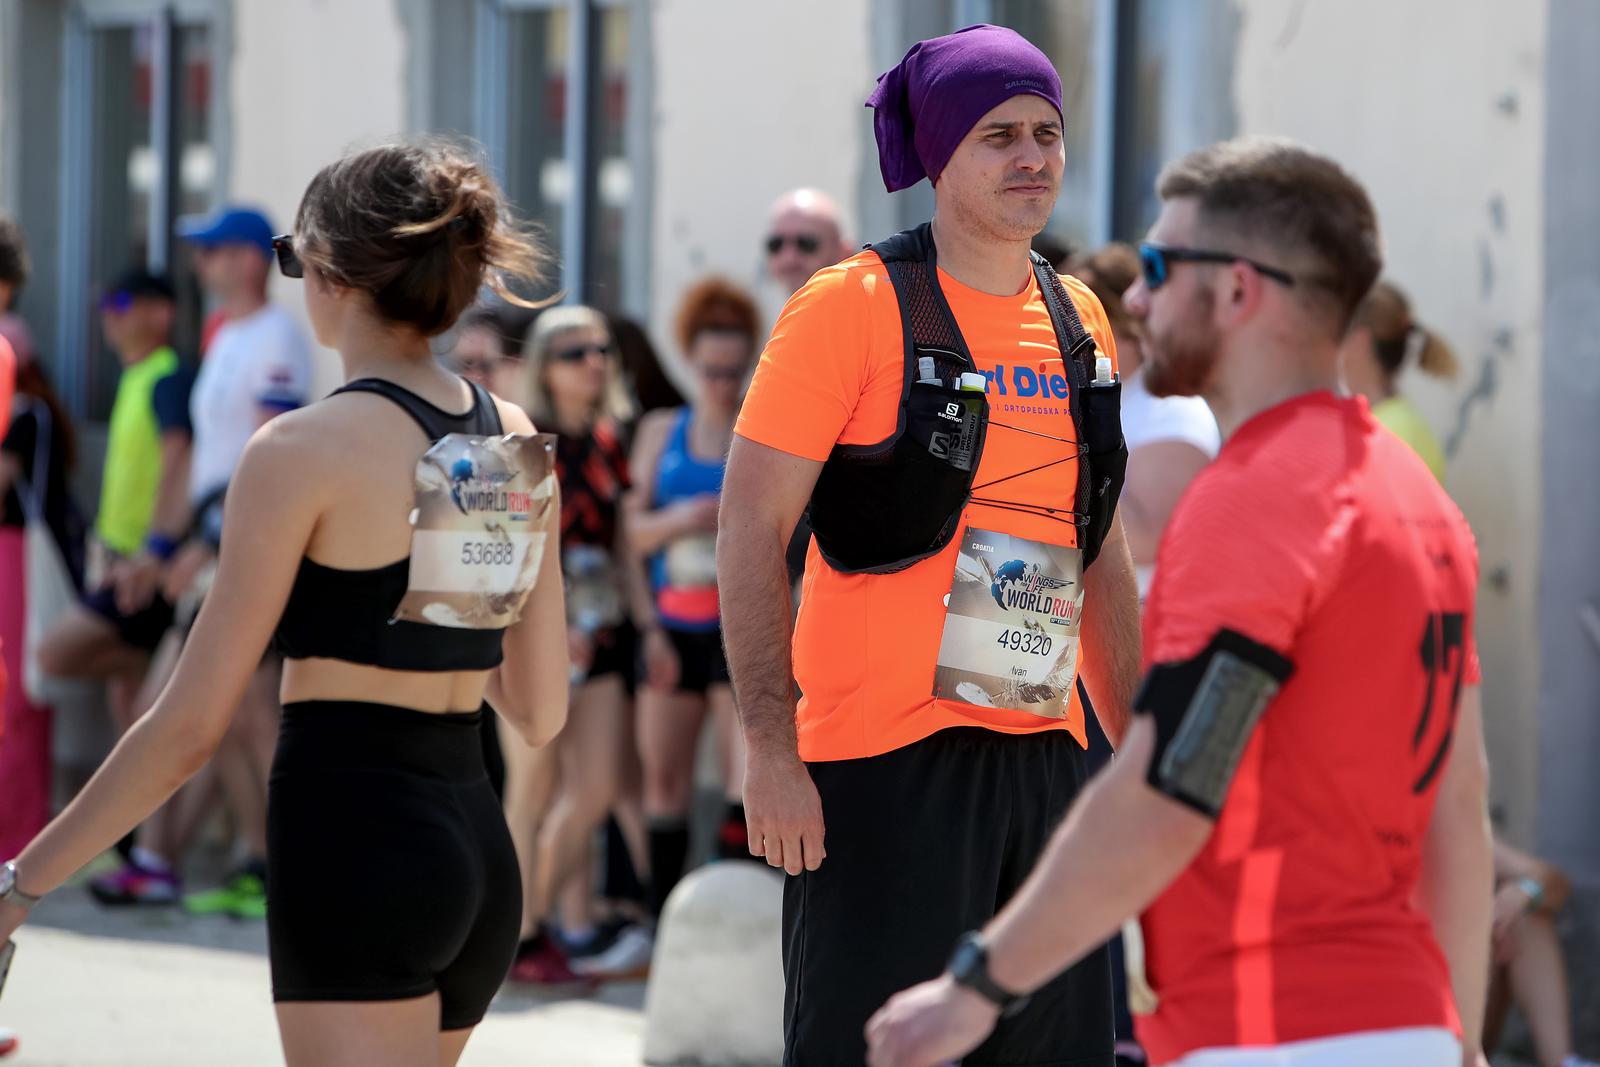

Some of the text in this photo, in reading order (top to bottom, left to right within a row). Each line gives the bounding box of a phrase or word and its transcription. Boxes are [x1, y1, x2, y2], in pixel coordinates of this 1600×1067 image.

[978, 363, 1068, 399] rl Die
[1004, 404, 1059, 415] ORTOPEDSKA
[465, 492, 532, 512] WORLD RUN
[461, 542, 513, 565] 53688
[972, 543, 994, 553] CROATIA
[1023, 574, 1054, 587] WINGS
[1026, 585, 1044, 594] LIFE
[1007, 588, 1074, 618] WORLD RUN
[997, 629, 1052, 656] 49320
[1011, 665, 1028, 677] Ivan
